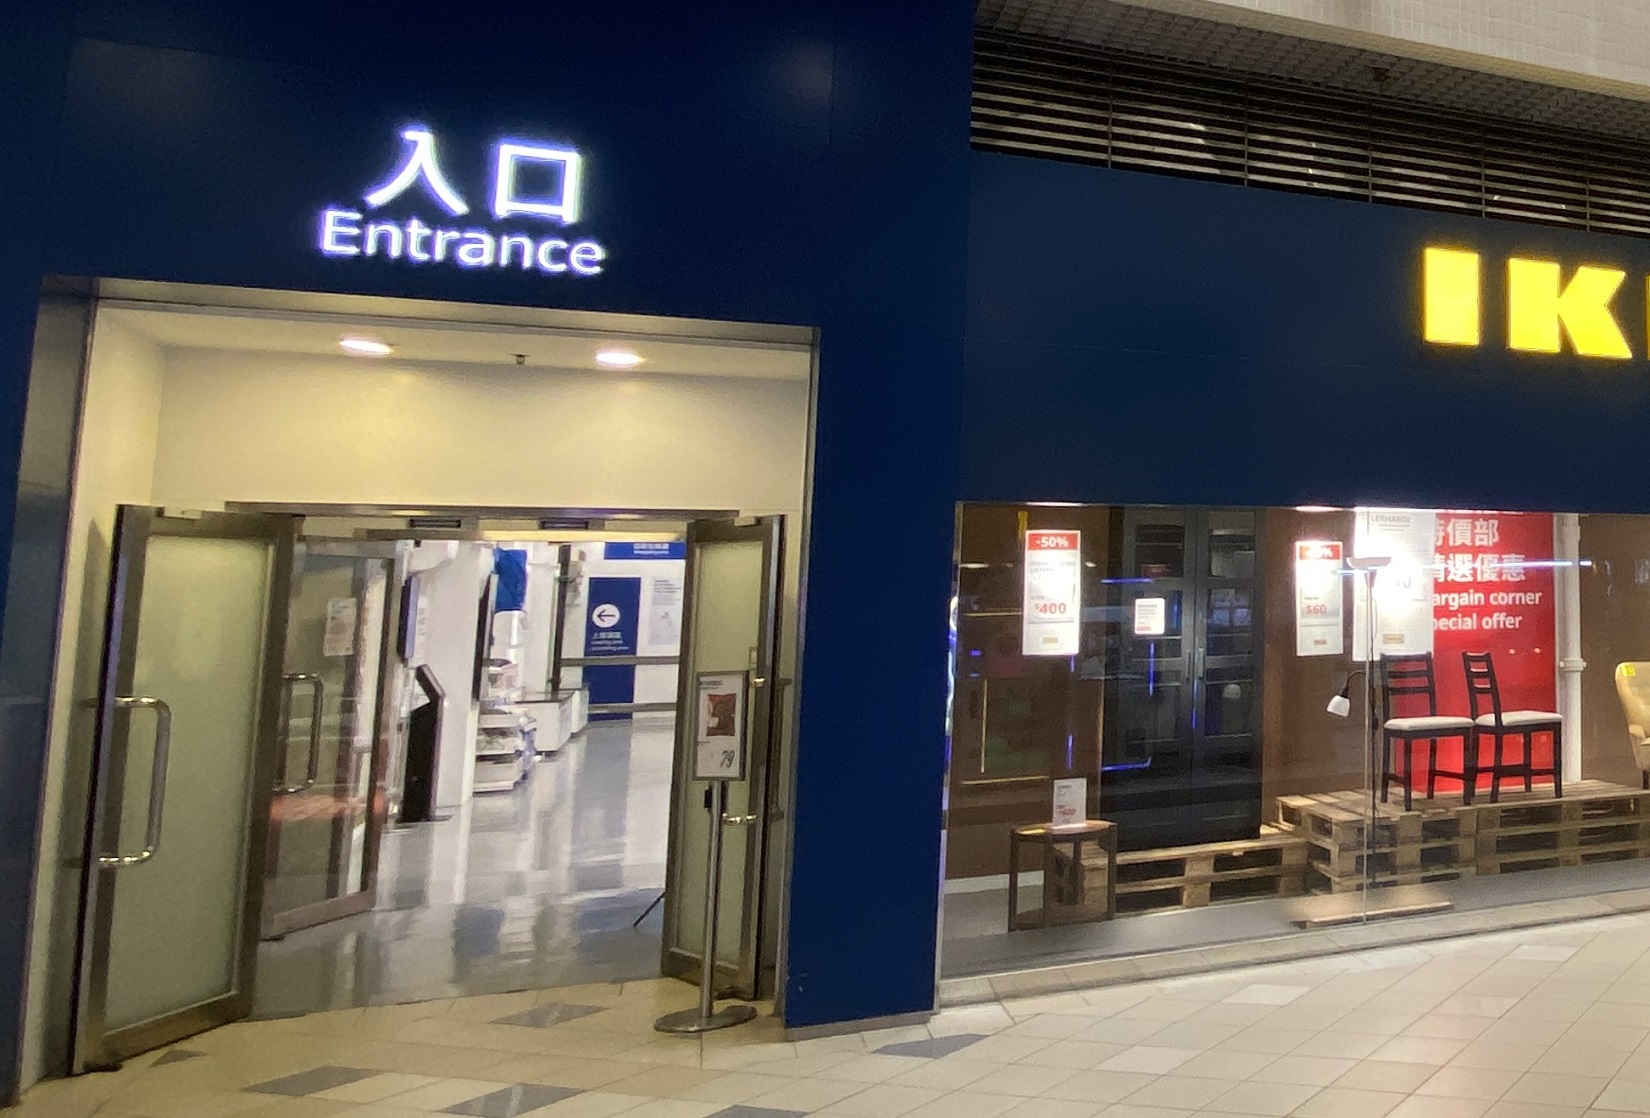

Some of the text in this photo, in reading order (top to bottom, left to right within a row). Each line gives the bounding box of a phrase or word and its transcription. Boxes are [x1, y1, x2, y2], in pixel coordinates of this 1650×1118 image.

[364, 129, 580, 224] 入口
[320, 208, 606, 275] Entrance
[1035, 536, 1069, 548] -50%
[1034, 602, 1067, 615] $400
[1432, 589, 1542, 611] argain corner
[1305, 604, 1327, 615] $60
[1432, 613, 1522, 630] pecial offer
